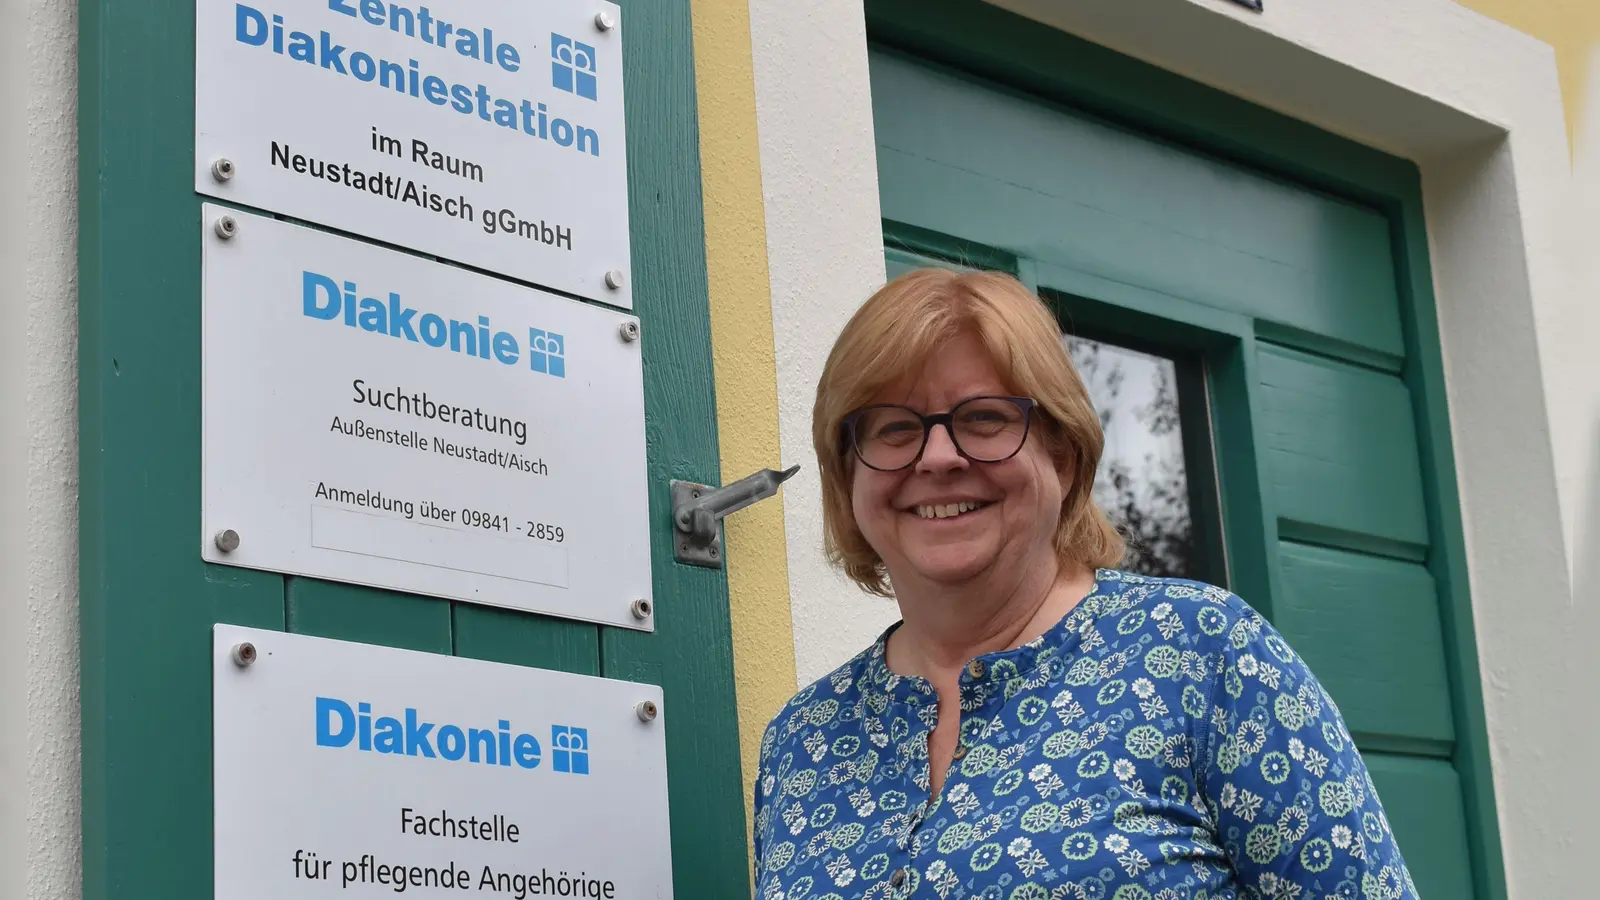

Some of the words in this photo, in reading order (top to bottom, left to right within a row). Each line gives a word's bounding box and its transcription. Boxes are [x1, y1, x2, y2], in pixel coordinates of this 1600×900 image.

[235, 3, 600, 156] Diakoniestation
[371, 127, 402, 157] im
[412, 139, 484, 183] Raum
[270, 141, 474, 222] Neustadt/Aisch
[482, 207, 573, 251] gGmbH
[302, 270, 520, 366] Diakonie
[352, 379, 528, 445] Suchtberatung
[330, 416, 428, 452] Außenstelle
[433, 437, 549, 477] Neustadt/Aisch
[315, 482, 414, 520] Anmeldung
[419, 500, 457, 524] über
[461, 507, 510, 534] 09841
[526, 521, 565, 544] 2859
[315, 696, 541, 769] Diakonie
[400, 807, 520, 843] Fachstelle
[292, 849, 332, 880] für
[342, 855, 471, 892] pflegende
[478, 864, 616, 900] Angehörige
